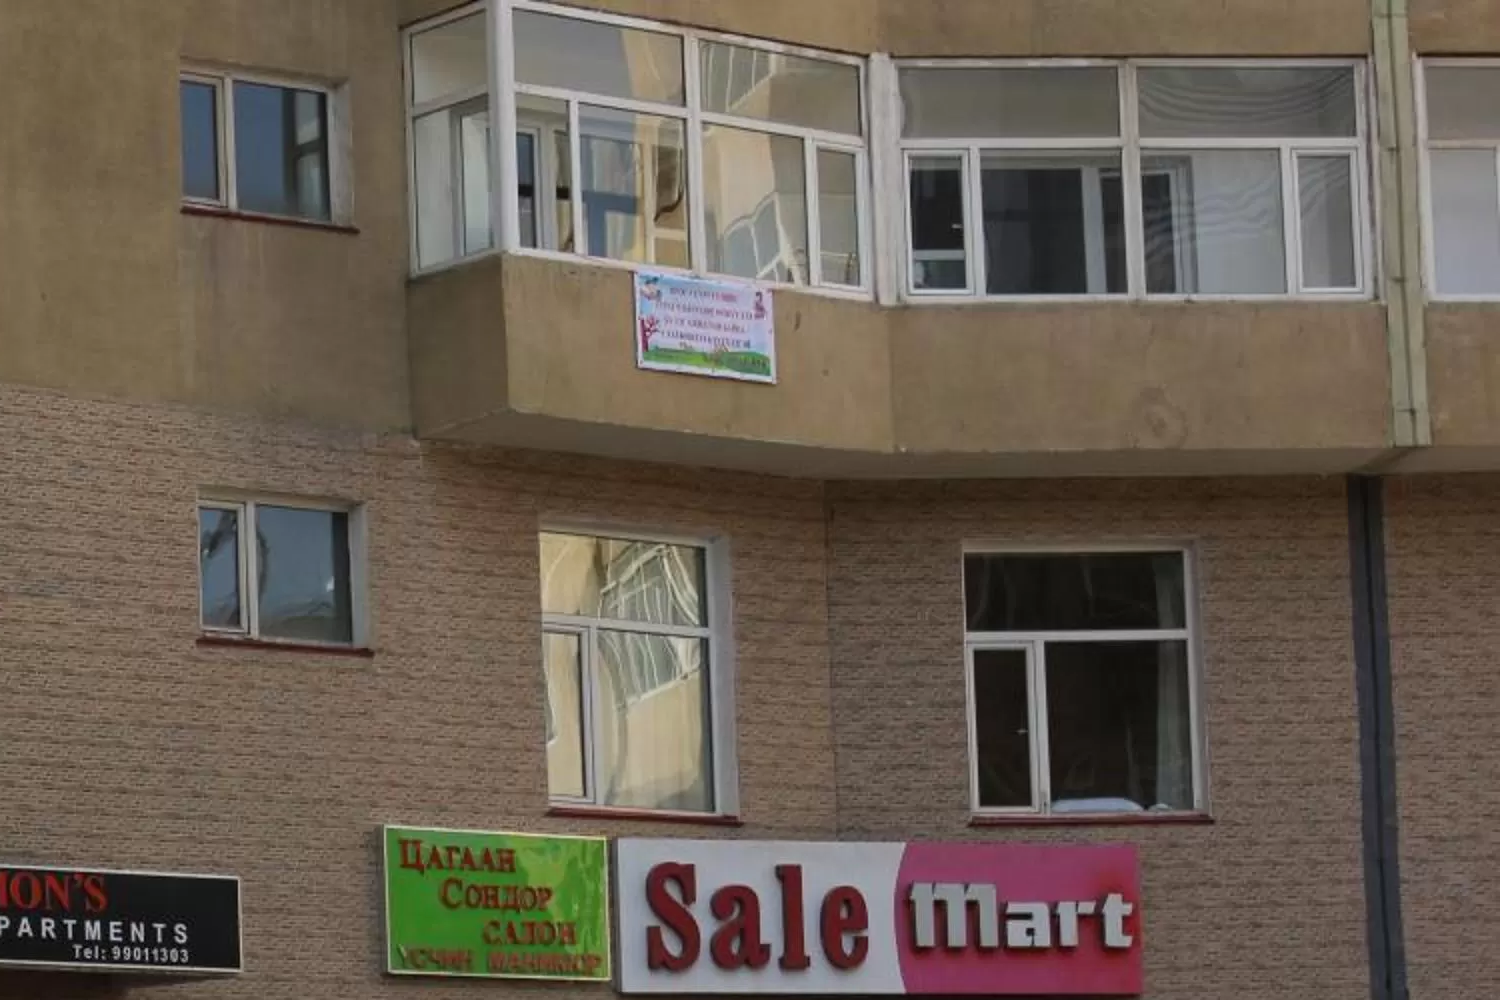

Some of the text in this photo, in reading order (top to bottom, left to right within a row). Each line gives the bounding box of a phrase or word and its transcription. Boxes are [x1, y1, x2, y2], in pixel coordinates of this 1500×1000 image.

[646, 861, 869, 973] Sale
[72, 944, 190, 963] Tel: 99011303
